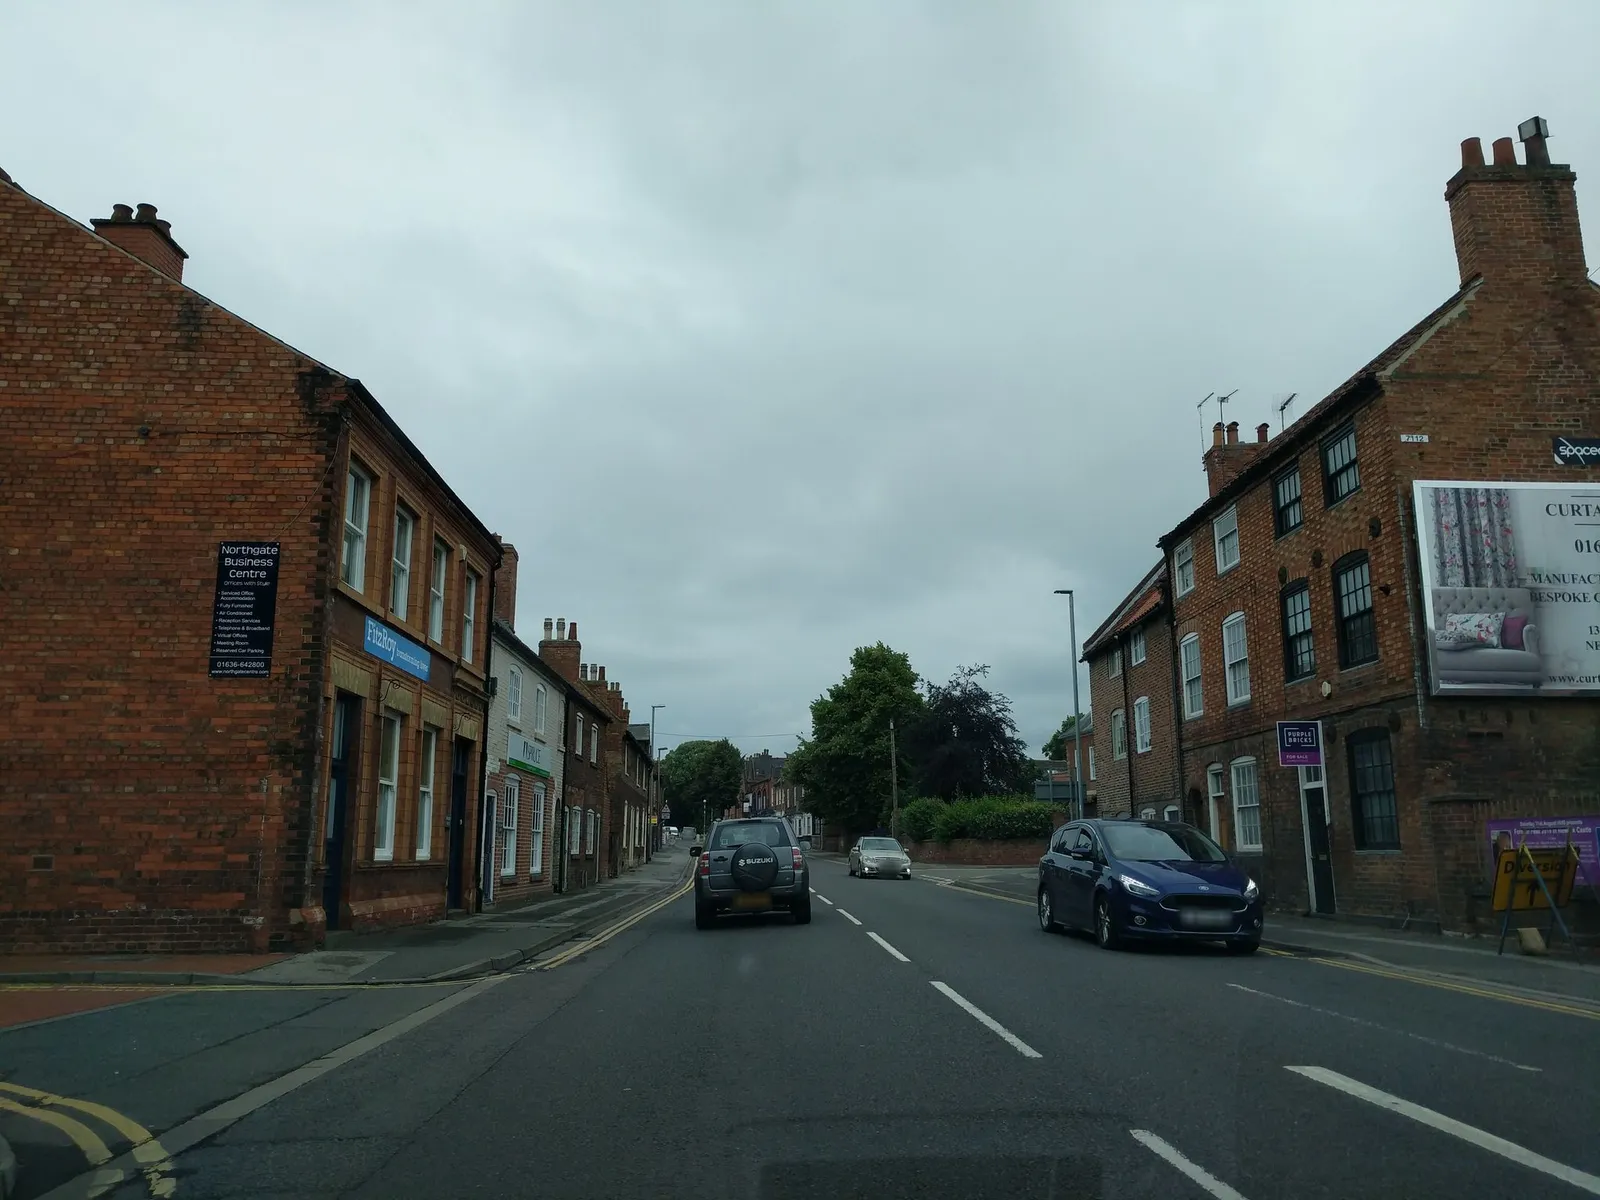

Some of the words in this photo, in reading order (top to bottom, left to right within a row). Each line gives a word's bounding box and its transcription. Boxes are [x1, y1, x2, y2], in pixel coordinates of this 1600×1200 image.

[1558, 444, 1600, 459] space
[221, 545, 278, 556] Northgate
[1574, 539, 1600, 553] 016
[224, 557, 274, 567] Business
[229, 569, 267, 579] Centre
[1530, 592, 1592, 603] BESPOKE
[1588, 625, 1600, 635] 13
[367, 620, 397, 661] FitzRoy
[746, 857, 774, 865] SUZUKI
[1504, 861, 1570, 873] Dversion
